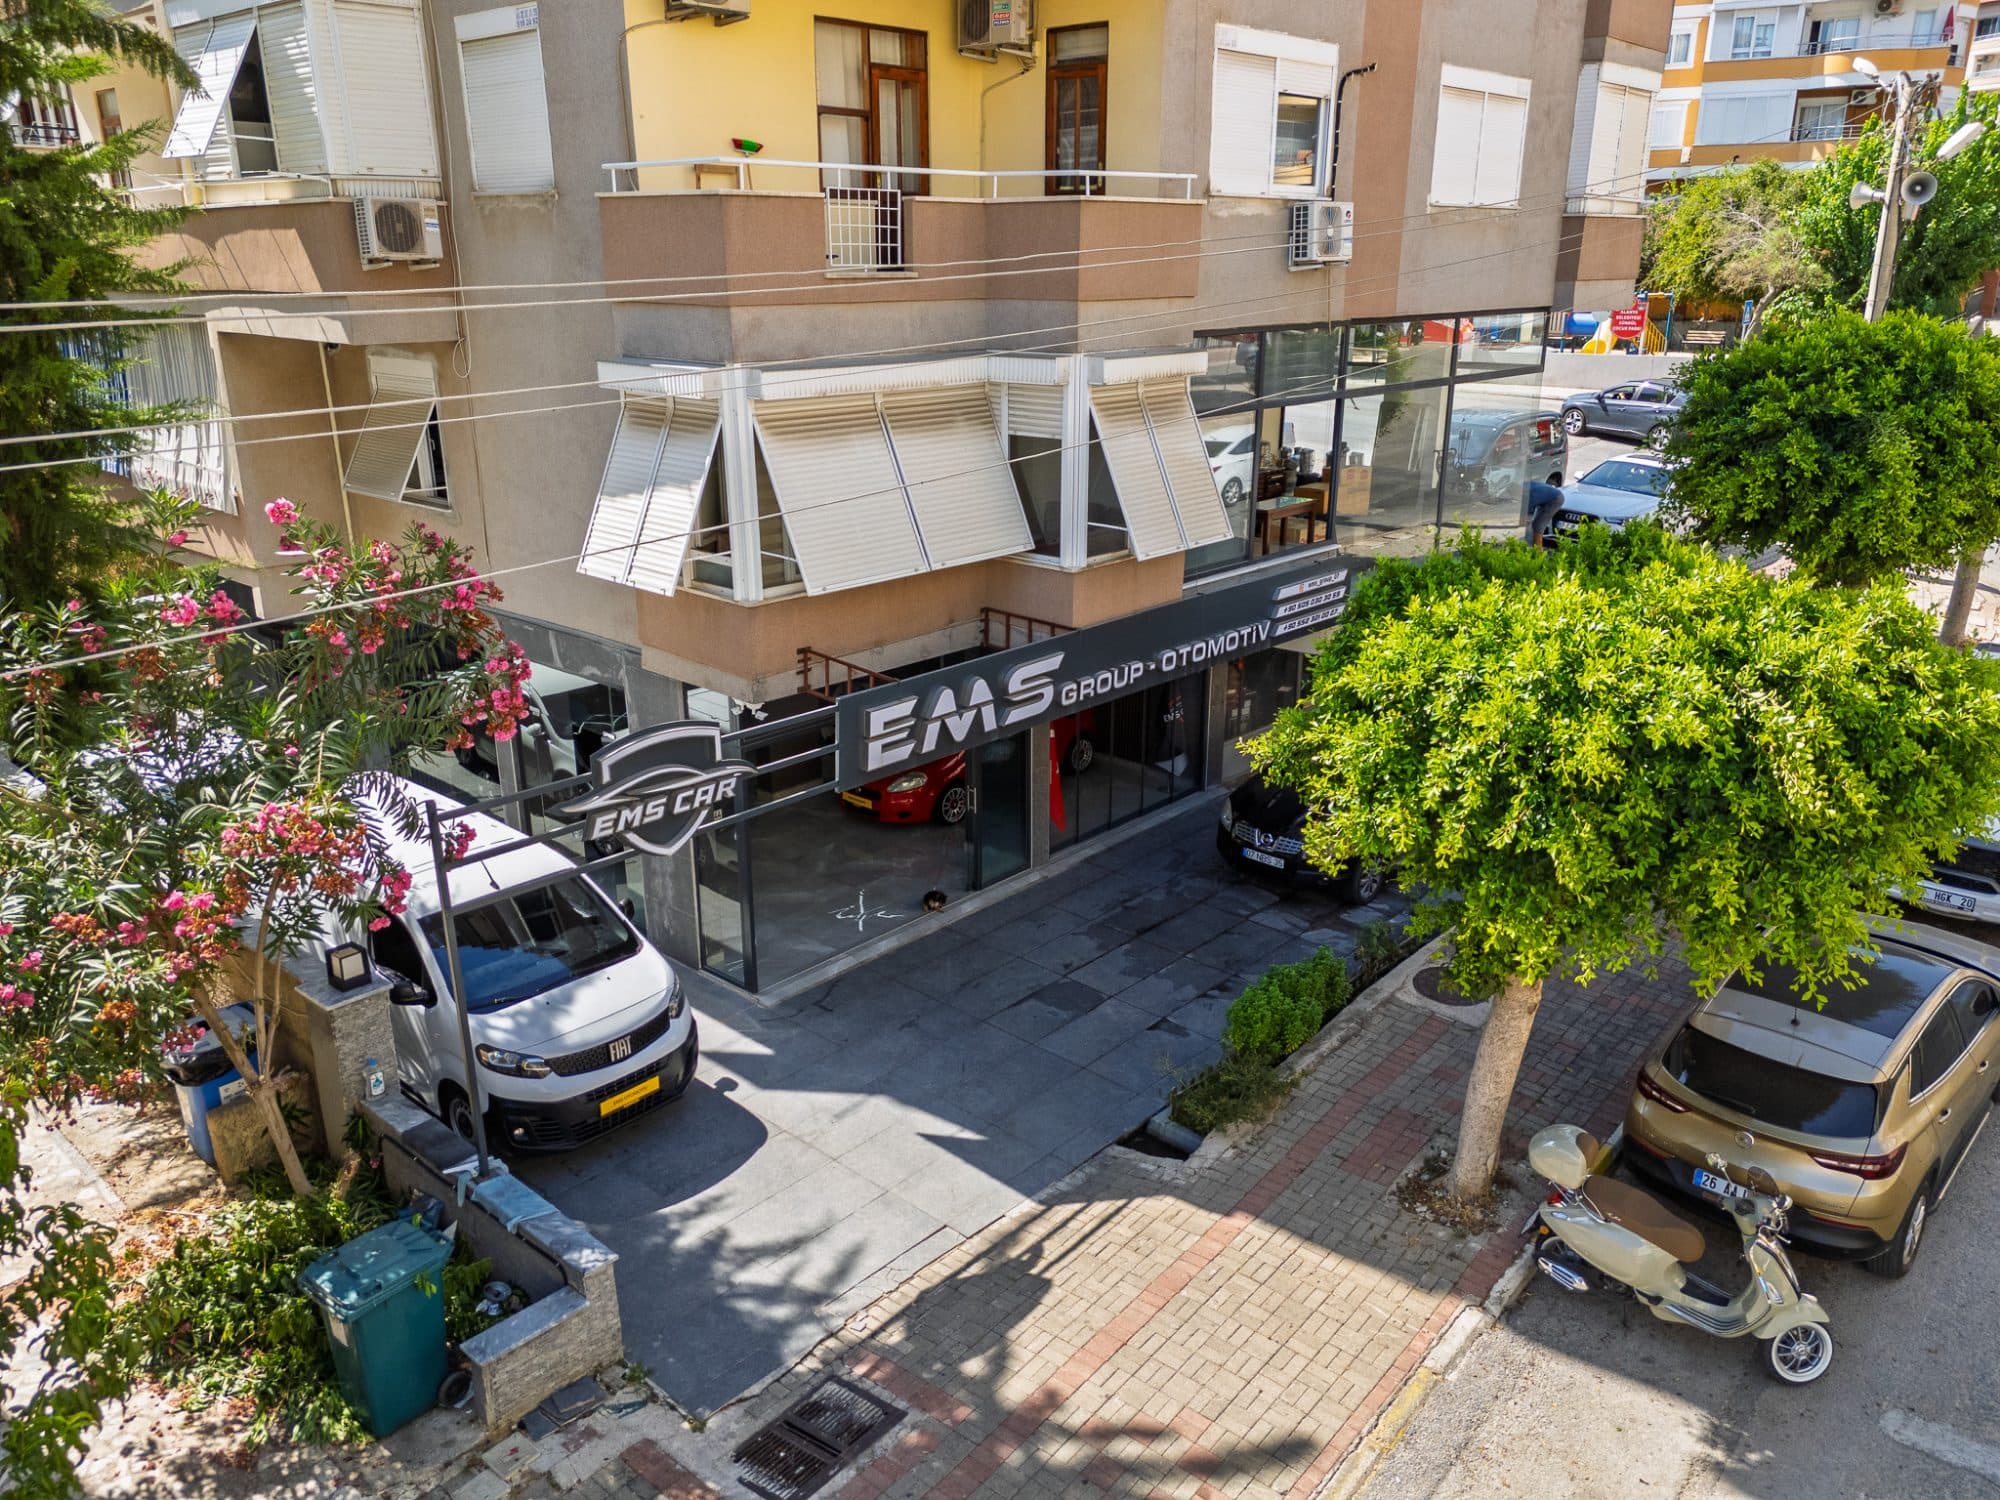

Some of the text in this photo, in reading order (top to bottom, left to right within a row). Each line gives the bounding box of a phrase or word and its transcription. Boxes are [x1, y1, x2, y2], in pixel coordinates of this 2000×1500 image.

[1284, 604, 1296, 613] +90
[1284, 621, 1296, 631] +90
[866, 652, 1064, 772] EMS
[1061, 661, 1144, 706] GROUP
[592, 777, 737, 841] EMS CAR
[1960, 898, 1973, 908] 20
[608, 1035, 632, 1063] FIAT
[1702, 1174, 1717, 1189] 26
